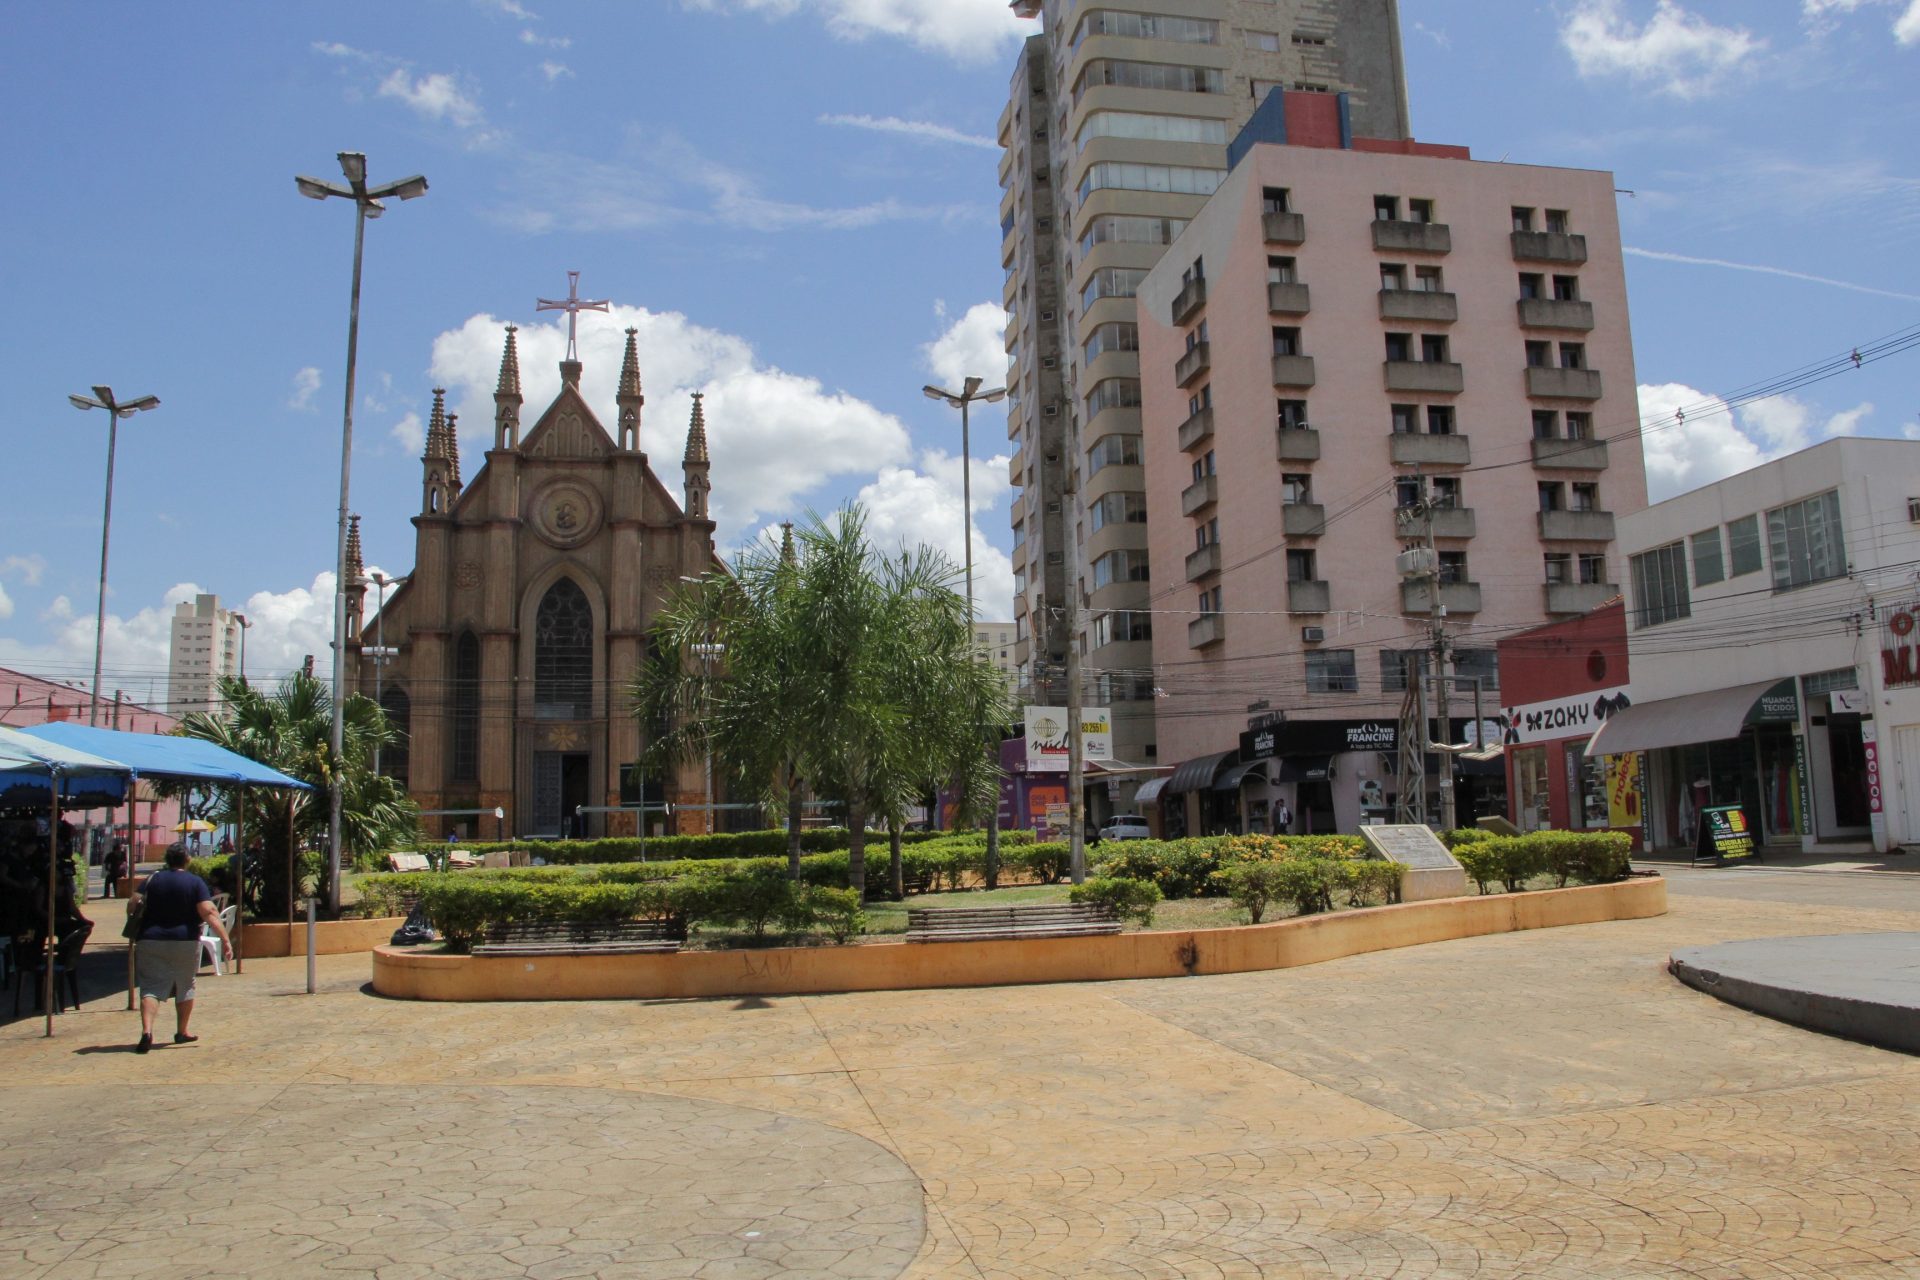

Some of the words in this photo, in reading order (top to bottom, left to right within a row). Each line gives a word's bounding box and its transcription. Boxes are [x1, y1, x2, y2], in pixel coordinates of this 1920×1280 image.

[1762, 696, 1795, 704] NUANCE
[1347, 733, 1395, 742] FRANCINE
[1800, 785, 1809, 834] TECIDOS
